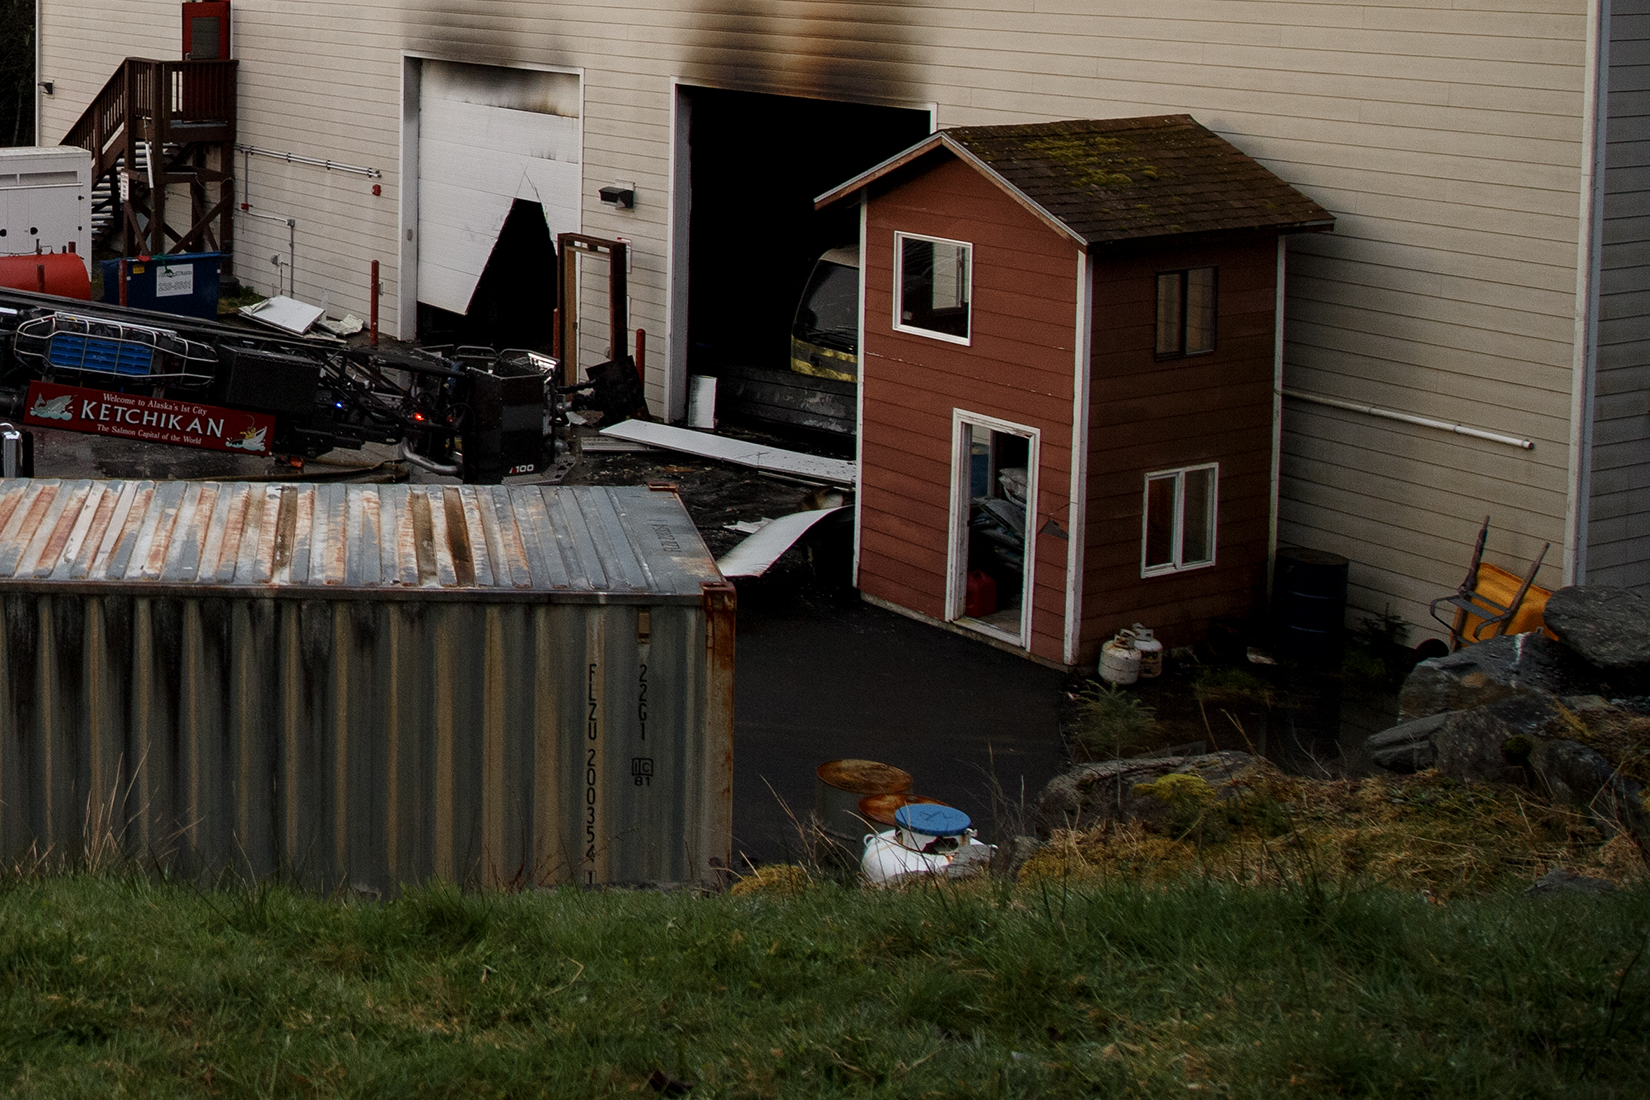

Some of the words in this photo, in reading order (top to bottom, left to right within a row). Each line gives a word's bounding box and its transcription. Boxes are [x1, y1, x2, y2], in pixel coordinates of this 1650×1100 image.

[80, 399, 225, 439] KETCHIKAN
[103, 393, 136, 405] Welcome
[147, 400, 179, 411] Alaska's
[192, 406, 208, 417] City
[97, 423, 110, 432] The
[111, 425, 136, 436] Salmon
[137, 429, 160, 439] Capital
[170, 434, 181, 442] the
[182, 435, 203, 445] World
[588, 663, 598, 740] FLZU
[637, 664, 648, 740] 22G1
[634, 776, 651, 787] 81
